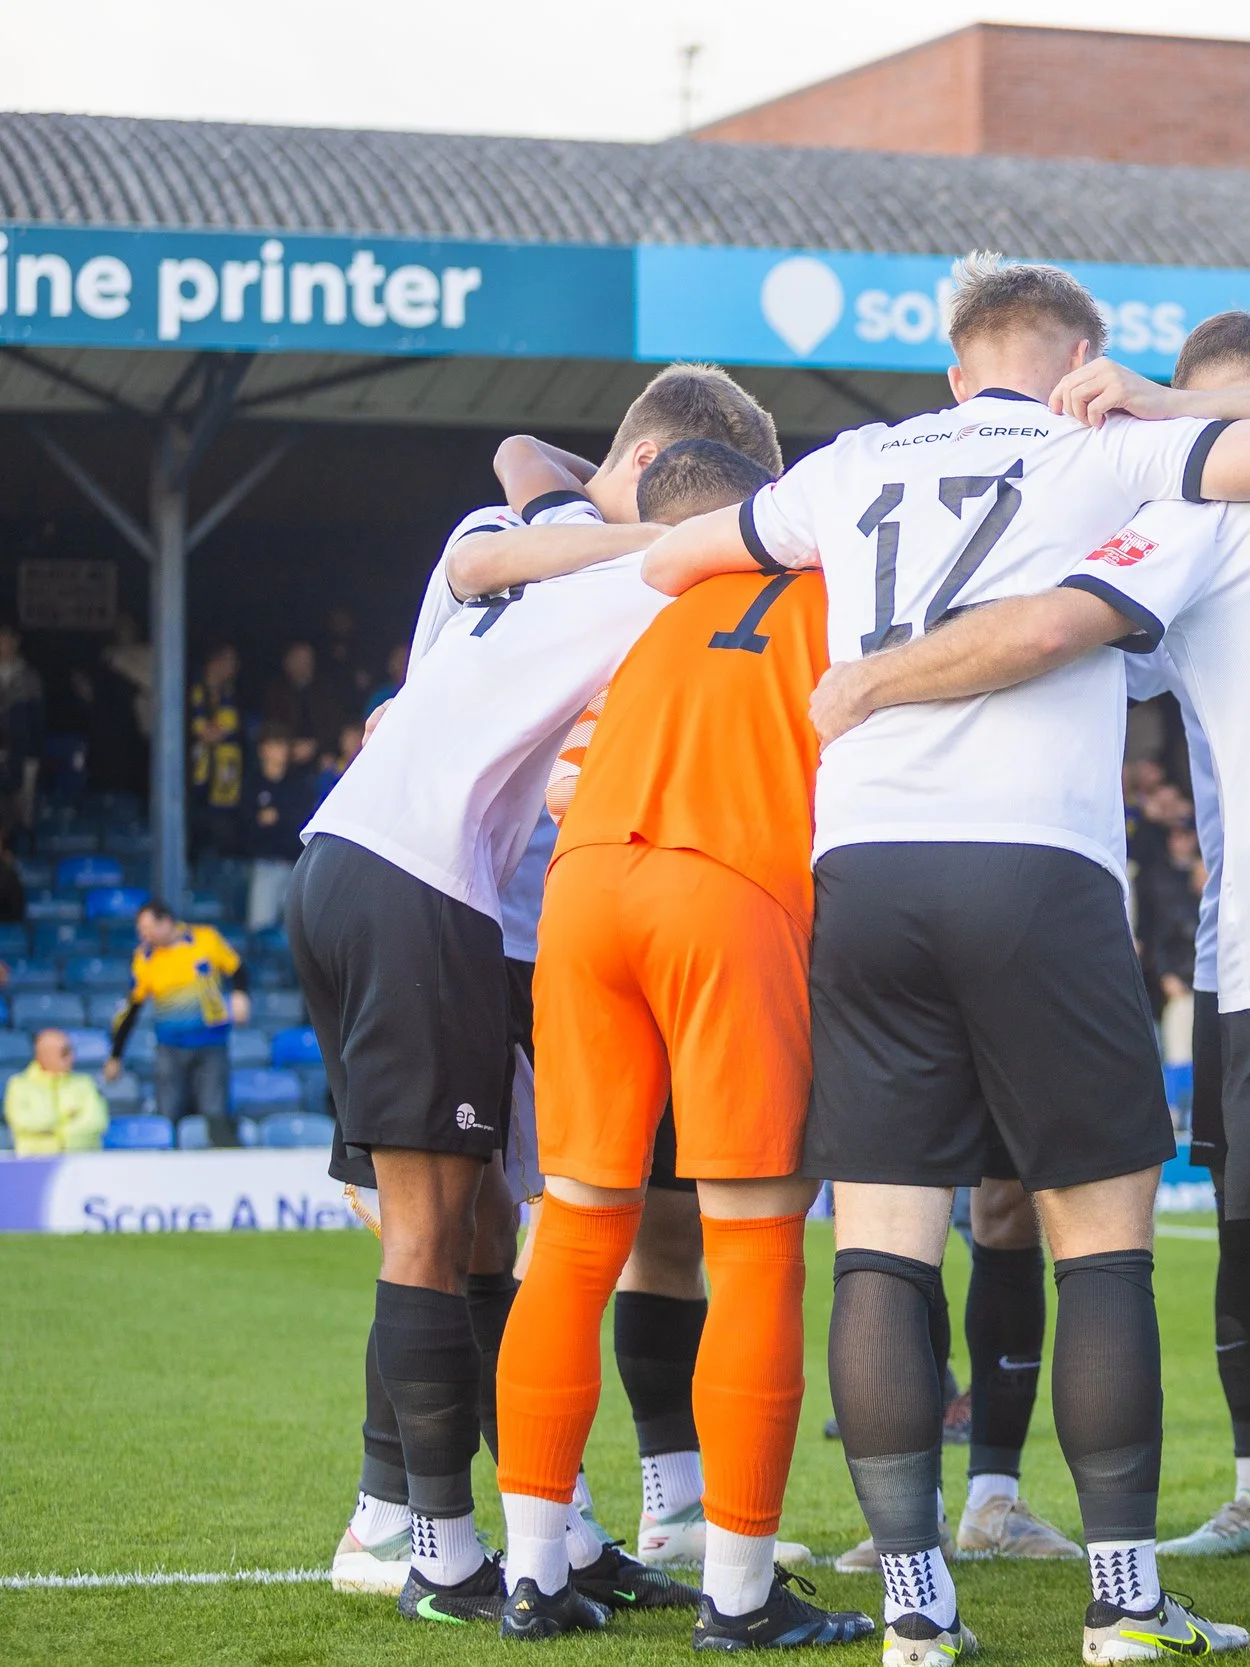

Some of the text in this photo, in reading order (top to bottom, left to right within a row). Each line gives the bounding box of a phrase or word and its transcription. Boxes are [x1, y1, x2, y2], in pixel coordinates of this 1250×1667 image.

[158, 239, 481, 341] printer
[855, 276, 1185, 354] soless
[879, 427, 1049, 452] FALCON GREEN
[83, 1196, 213, 1233] Score
[230, 1196, 259, 1231] A
